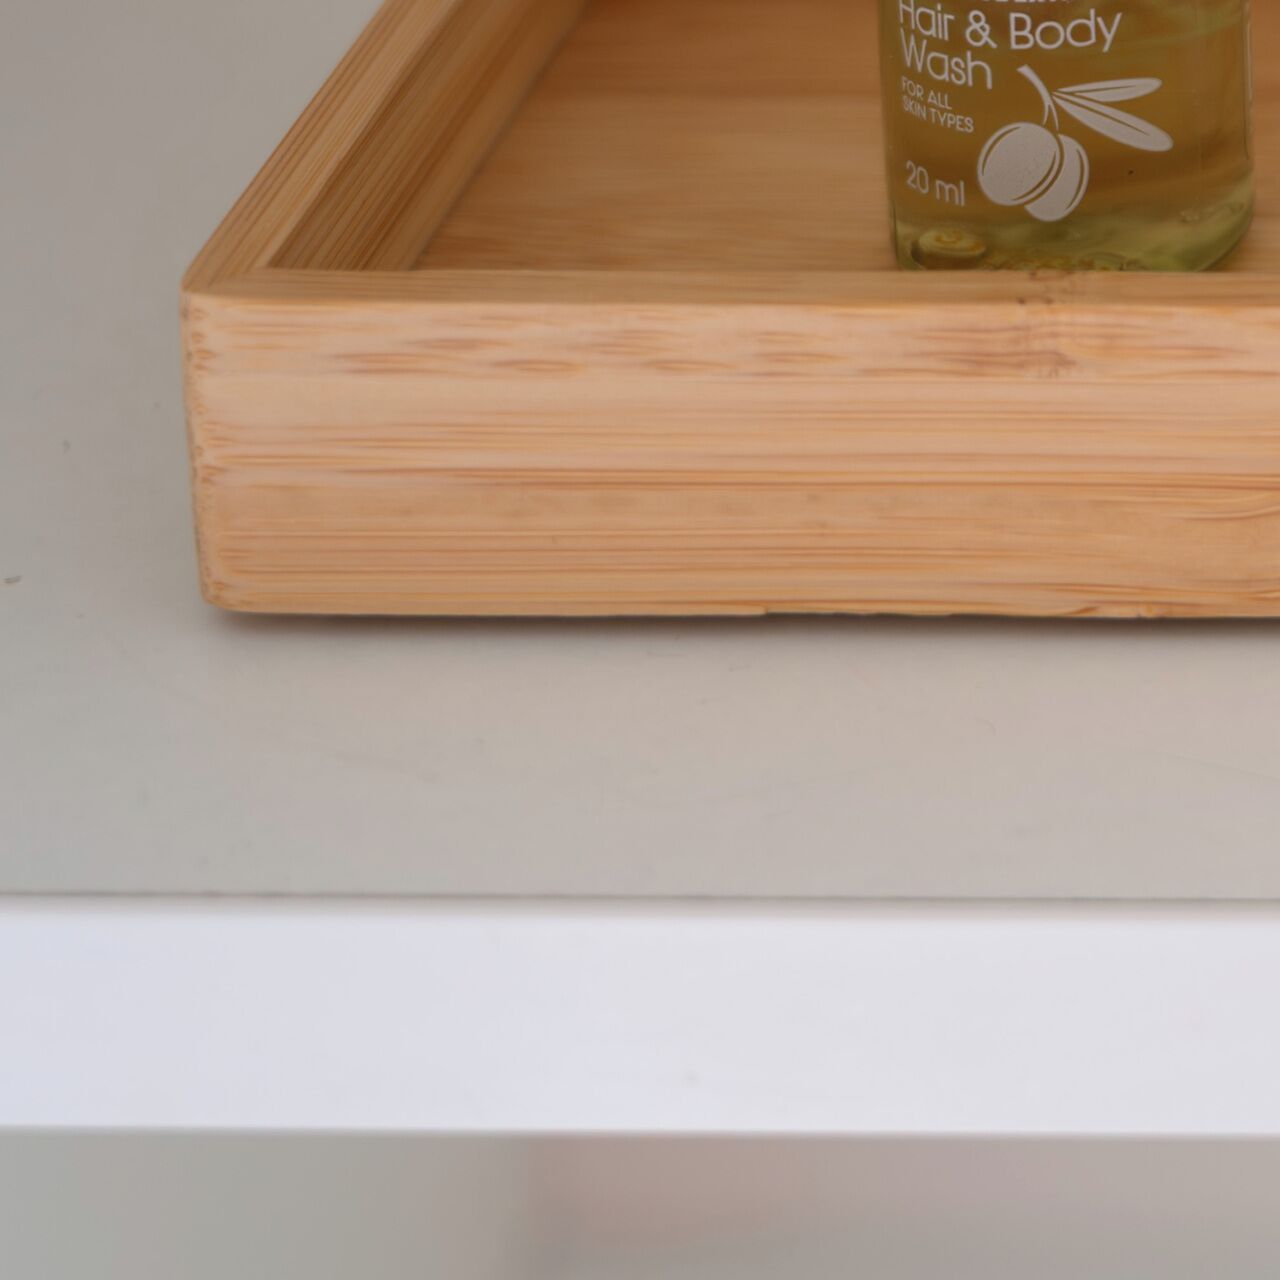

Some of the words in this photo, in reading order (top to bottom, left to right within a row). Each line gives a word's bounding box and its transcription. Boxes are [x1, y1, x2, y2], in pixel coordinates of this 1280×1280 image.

[966, 10, 997, 49] &
[1010, 9, 1122, 52] Body
[901, 28, 992, 89] Wash
[902, 76, 923, 100] FOR
[928, 89, 952, 110] ALL
[902, 98, 926, 121] SKIN
[930, 108, 973, 133] TYPES
[906, 160, 929, 194] 20
[935, 177, 964, 206] ml
